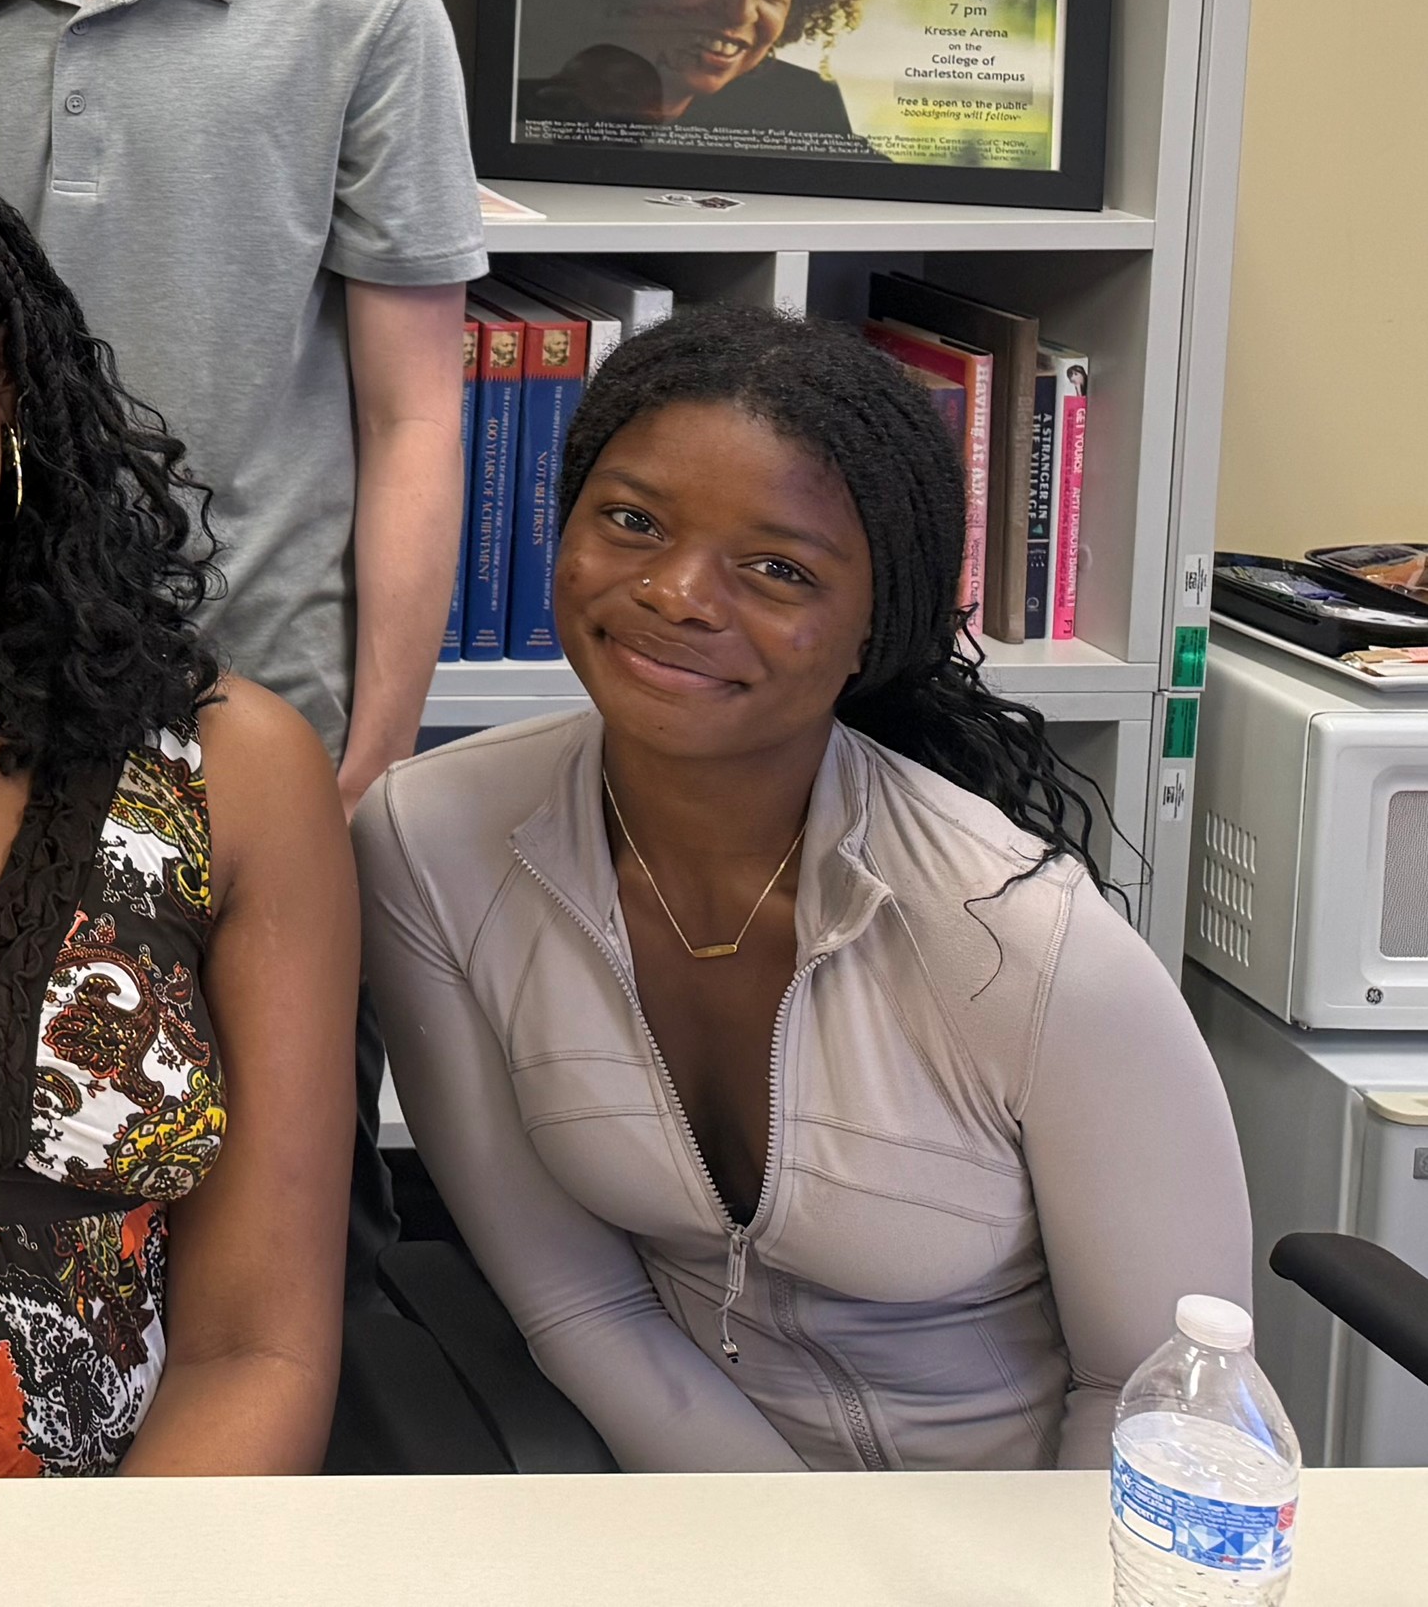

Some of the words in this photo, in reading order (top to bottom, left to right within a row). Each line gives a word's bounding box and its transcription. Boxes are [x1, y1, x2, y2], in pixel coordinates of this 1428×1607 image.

[950, 3, 958, 14] 7
[964, 6, 986, 17] pm
[924, 26, 966, 36] Kresse
[970, 27, 1007, 37] Arena
[932, 54, 978, 67] College
[982, 56, 995, 66] of
[905, 67, 972, 79] Charleston
[977, 72, 1024, 83] campus
[1041, 427, 1052, 501] STRANGER
